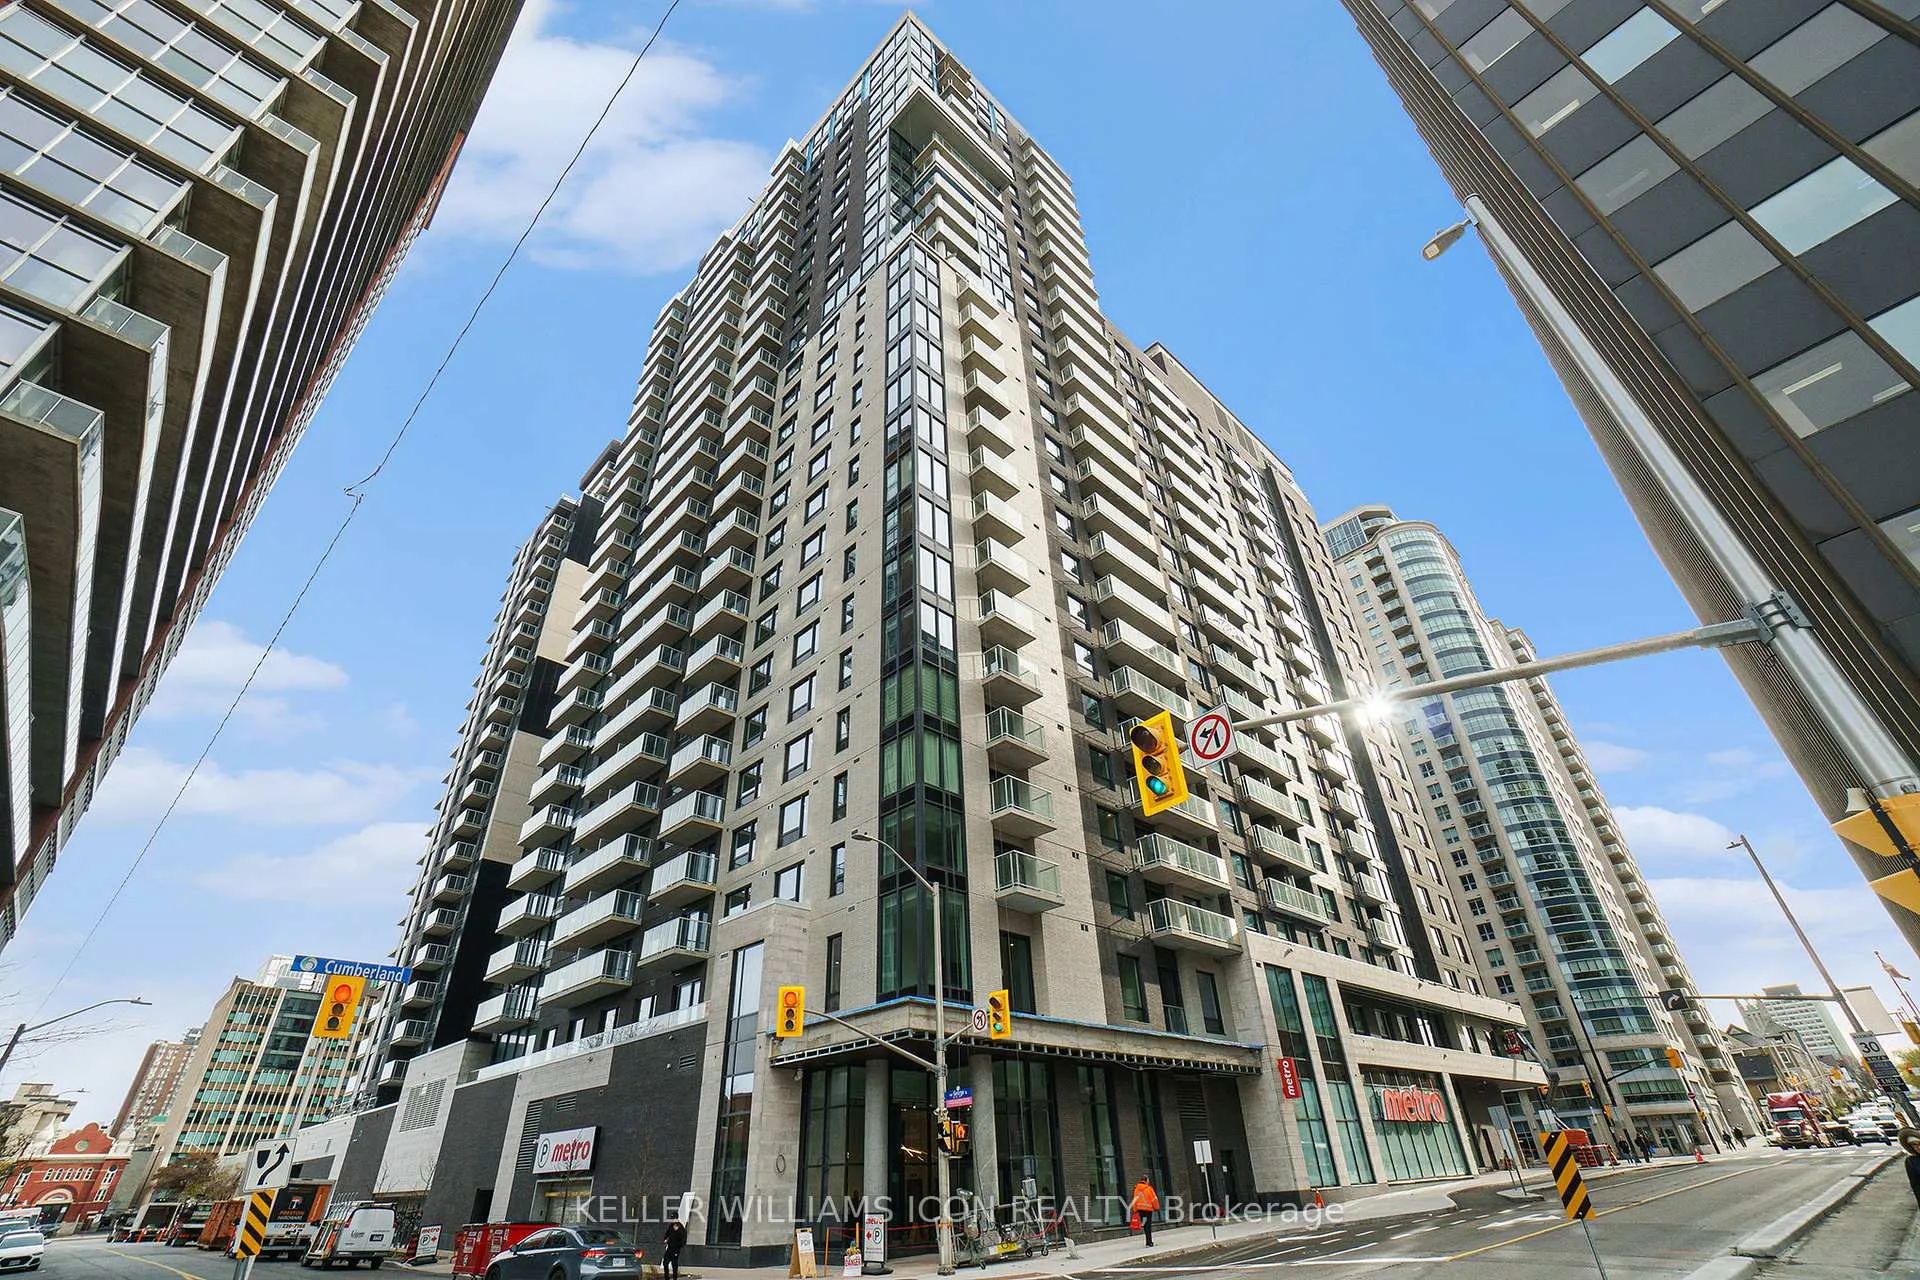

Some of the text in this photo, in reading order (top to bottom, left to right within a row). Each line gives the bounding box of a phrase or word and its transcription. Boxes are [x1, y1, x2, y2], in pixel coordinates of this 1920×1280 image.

[325, 960, 404, 981] Cumberland
[1859, 1041, 1880, 1053] 30
[1282, 1060, 1296, 1096] metro
[1382, 1084, 1446, 1123] metro
[551, 1140, 591, 1162] metro
[865, 1217, 884, 1225] metro
